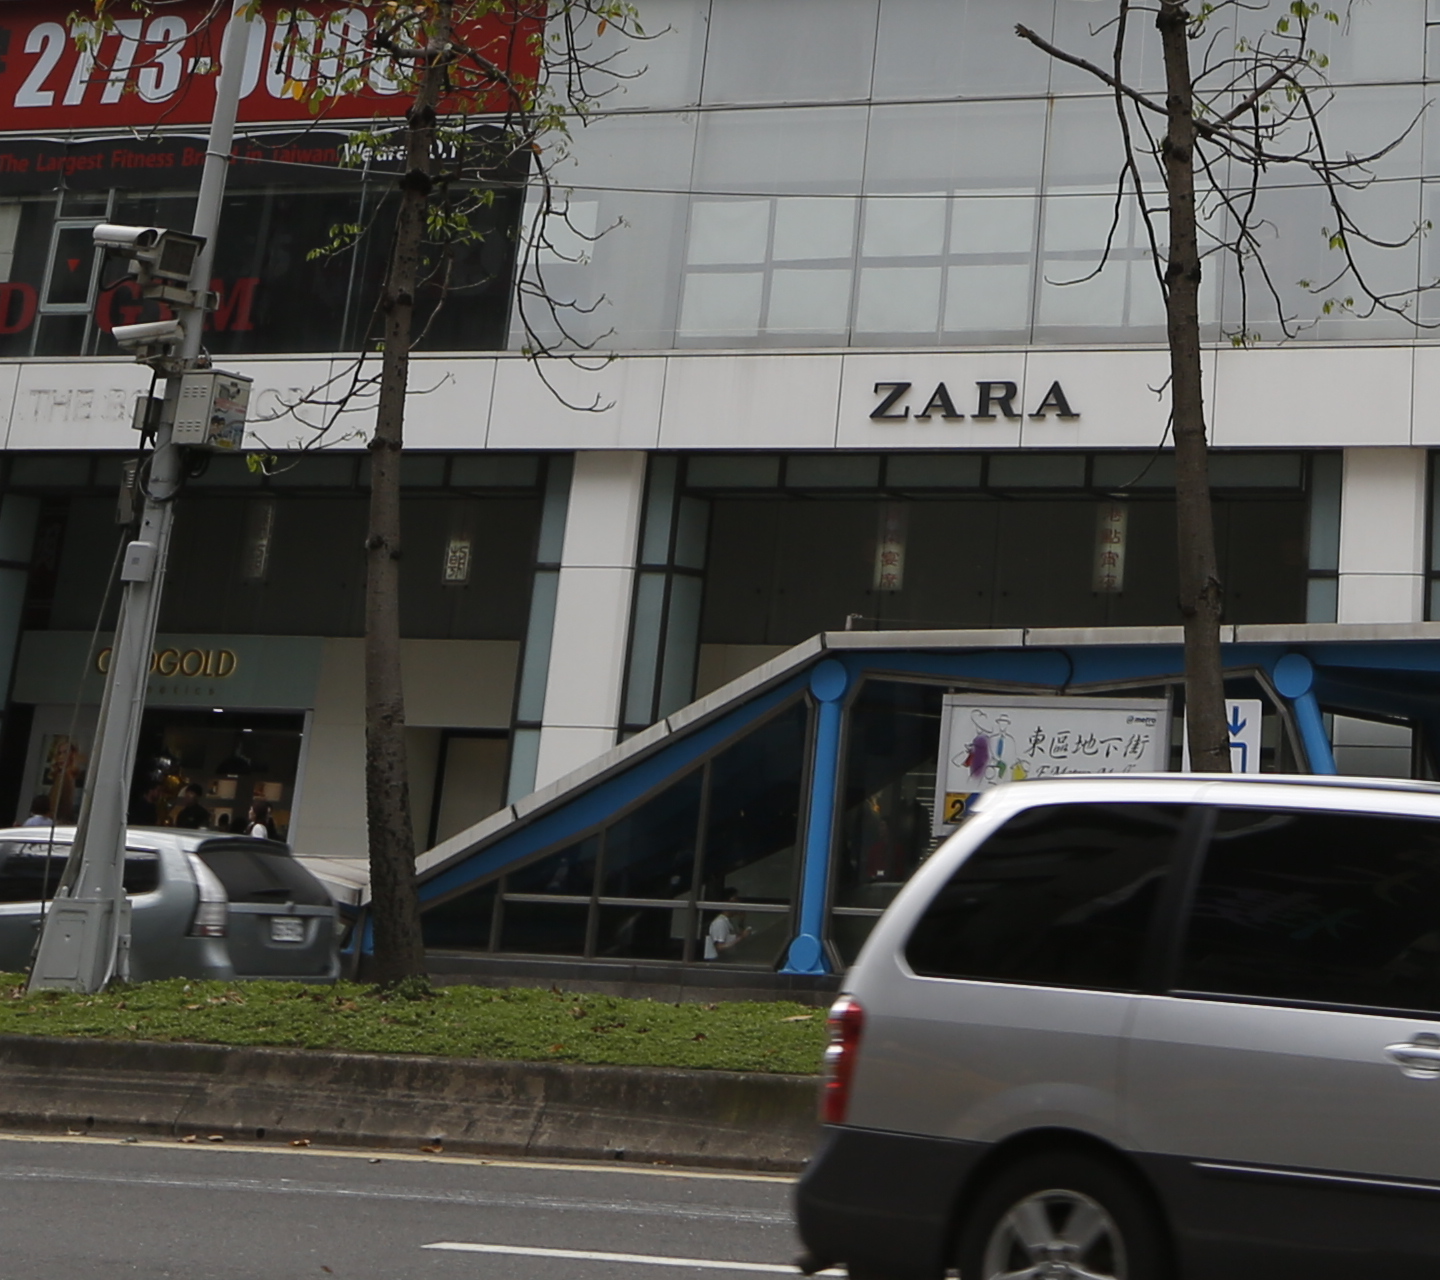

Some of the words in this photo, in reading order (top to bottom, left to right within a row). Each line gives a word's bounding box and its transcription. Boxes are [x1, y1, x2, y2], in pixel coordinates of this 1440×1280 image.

[35, 151, 103, 176] Largest
[110, 148, 175, 170] Fitness
[181, 146, 239, 167] Brd
[98, 277, 260, 334] GM
[870, 379, 1081, 421] ZARA
[1022, 725, 1150, 761] 東區地下街
[949, 799, 965, 821] 2
